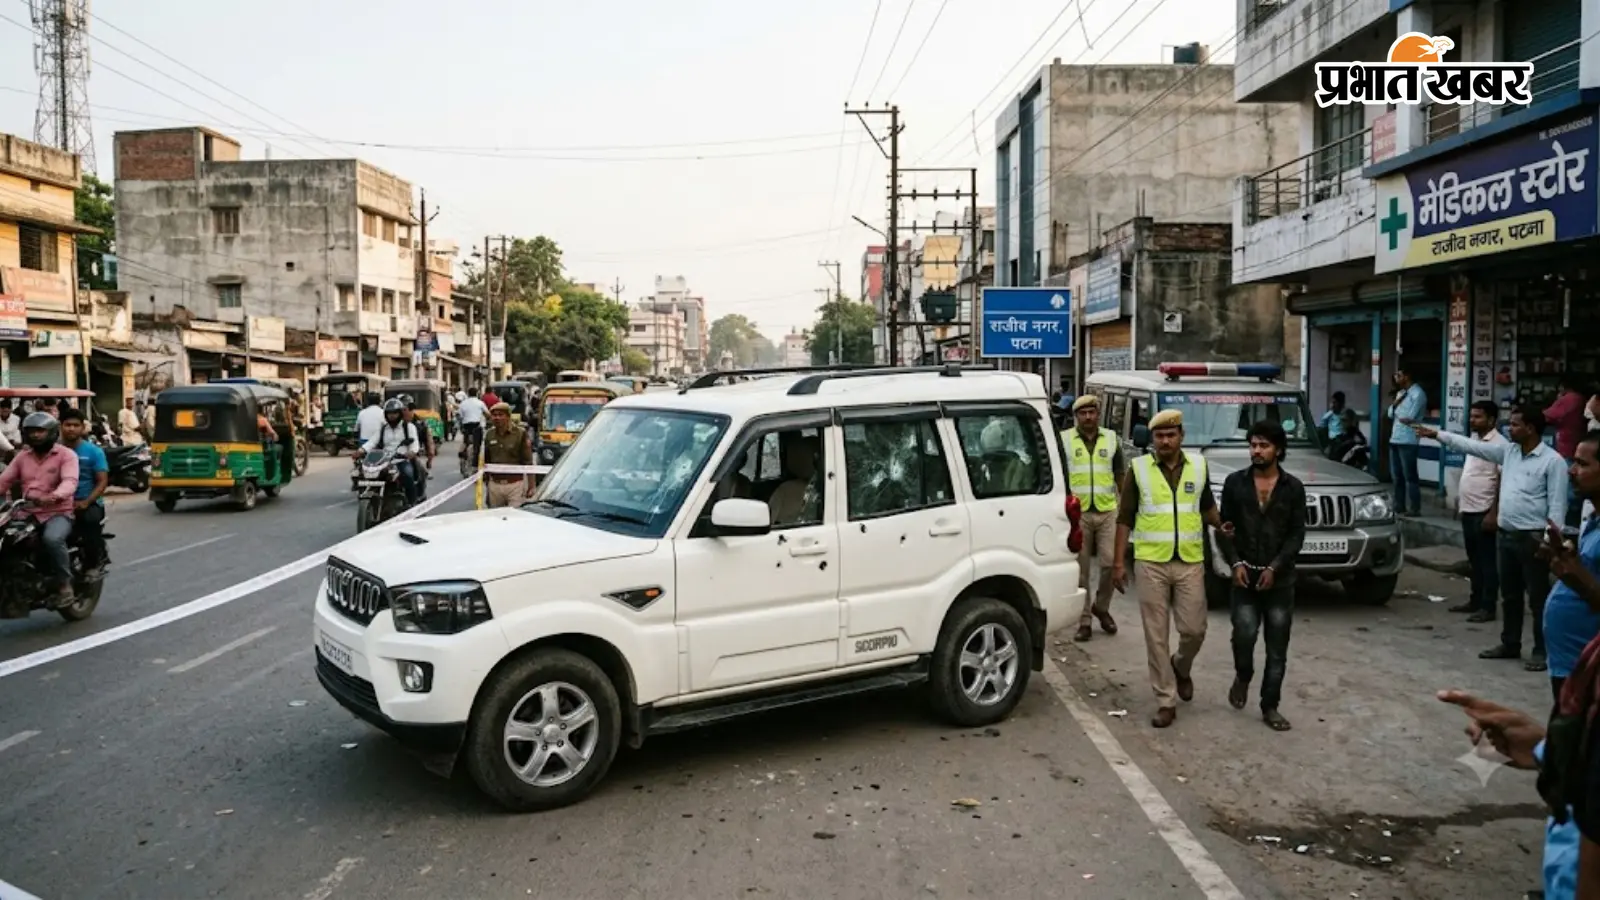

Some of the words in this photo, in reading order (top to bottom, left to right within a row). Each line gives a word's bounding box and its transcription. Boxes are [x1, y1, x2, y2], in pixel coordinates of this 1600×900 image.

[1418, 171, 1515, 227] मेडिकल
[1519, 141, 1589, 204] स्टोर
[1431, 233, 1467, 256] राजीव
[1508, 219, 1545, 241] पटना
[988, 316, 1028, 333] राजीव
[1010, 338, 1042, 350] पटना
[854, 634, 898, 654] SCORPIO
